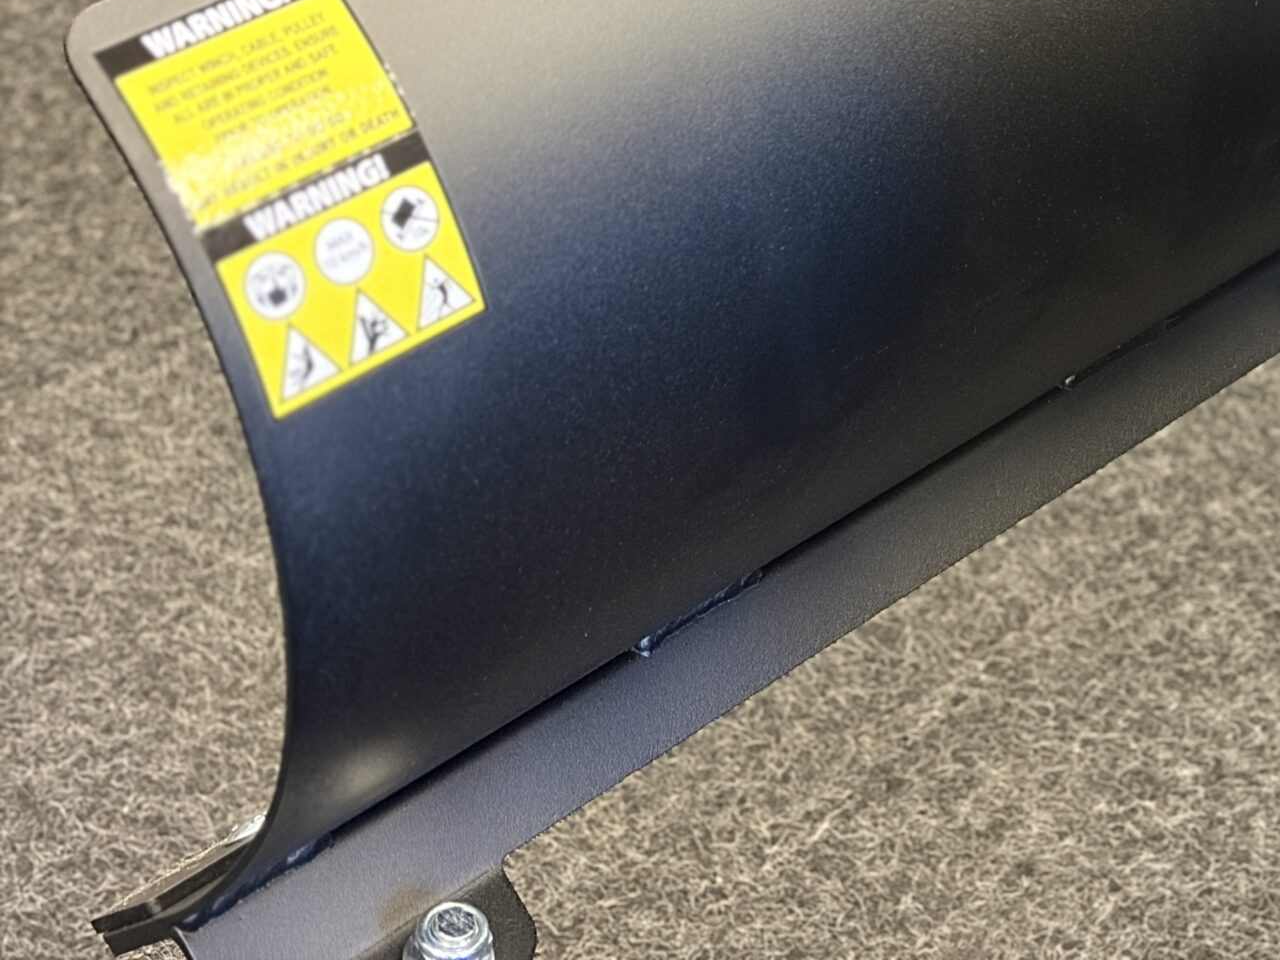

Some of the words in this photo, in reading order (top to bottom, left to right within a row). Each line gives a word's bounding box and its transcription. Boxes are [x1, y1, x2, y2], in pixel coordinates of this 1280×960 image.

[281, 11, 325, 37] PULLEY
[152, 93, 179, 112] AND
[292, 24, 339, 52] ENSURE
[171, 106, 195, 124] ALL
[195, 95, 219, 113] ARE
[234, 68, 282, 96] PROPER
[282, 56, 307, 74] AND
[306, 42, 339, 63] SAFE
[199, 94, 267, 130] OPERATING
[357, 107, 400, 134] DEATH
[243, 153, 390, 241] WARNING!
